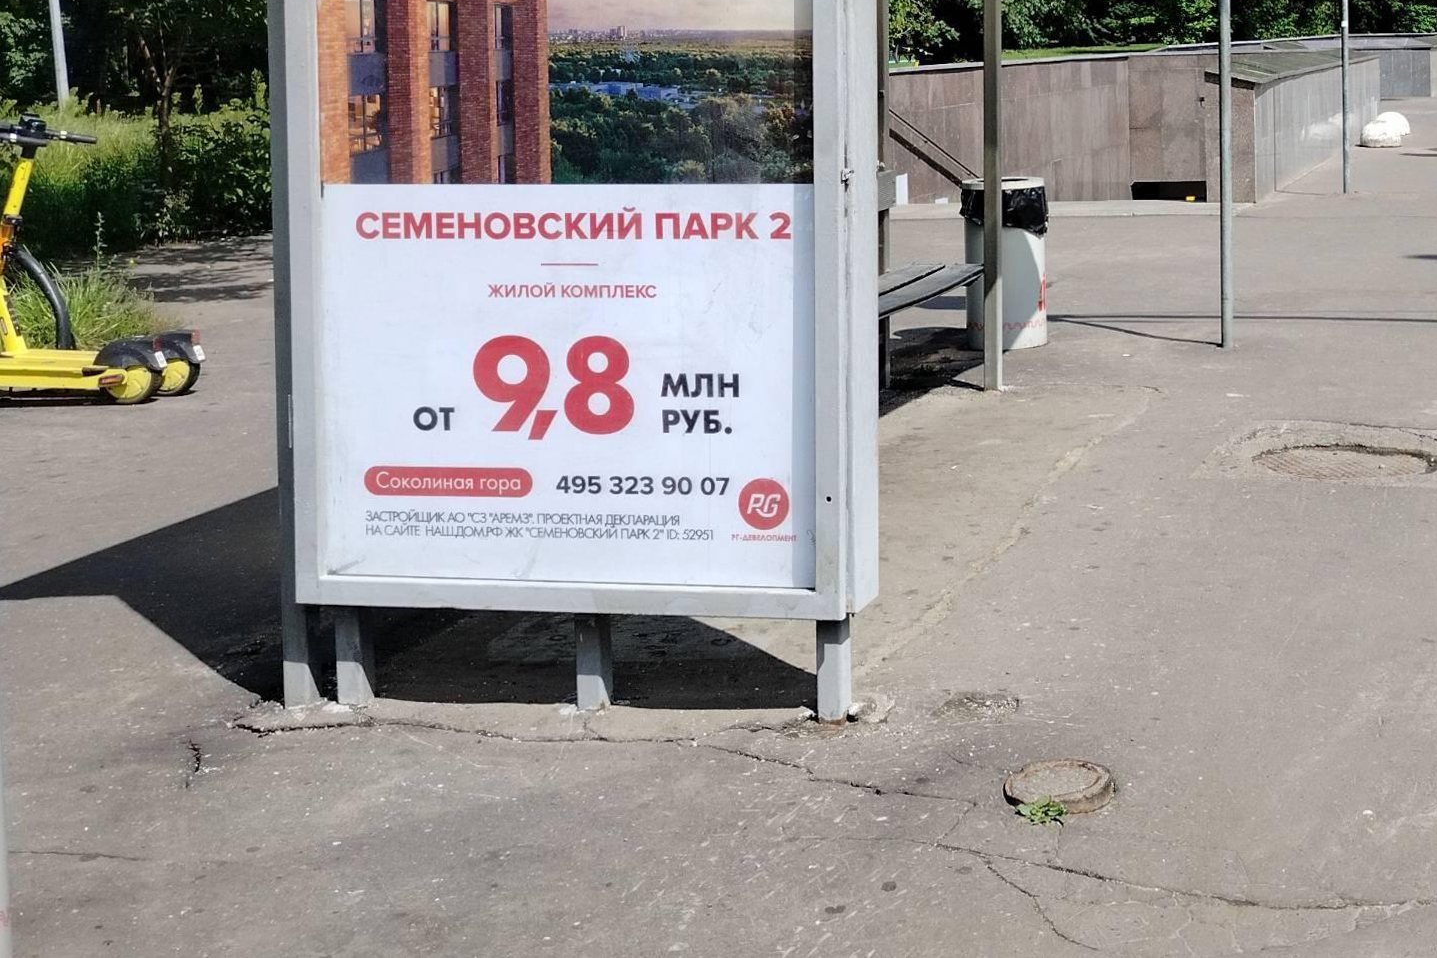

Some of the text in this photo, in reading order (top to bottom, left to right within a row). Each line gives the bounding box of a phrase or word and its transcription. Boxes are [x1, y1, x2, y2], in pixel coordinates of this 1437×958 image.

[355, 206, 792, 240] СЕМЕНОВСКИЙ ПАРК 2
[488, 281, 657, 299] ЖИЛОЙ КОМПЛЕКС
[412, 334, 635, 441] ОТ 9,8
[660, 372, 740, 398] МЛН
[661, 409, 733, 435] РУБ.
[375, 472, 521, 495] Соколиная гора
[555, 475, 730, 496] 495 323 90 07
[365, 509, 445, 524] ЗАСТРОЙЩИК
[447, 511, 465, 524] АО
[537, 513, 602, 526] ПРОЕКТНАЯ
[604, 514, 680, 528] ДЕКЛАРАЦИЯ
[365, 524, 382, 536] НА
[384, 522, 420, 536] САЙТЕ
[505, 526, 523, 538] ЖК
[525, 524, 619, 539] "СЕМЕНОВСКИЙ
[620, 527, 650, 540] ПАРК
[652, 528, 664, 540] 2"
[666, 528, 680, 540] ID:
[682, 528, 714, 541] 52951
